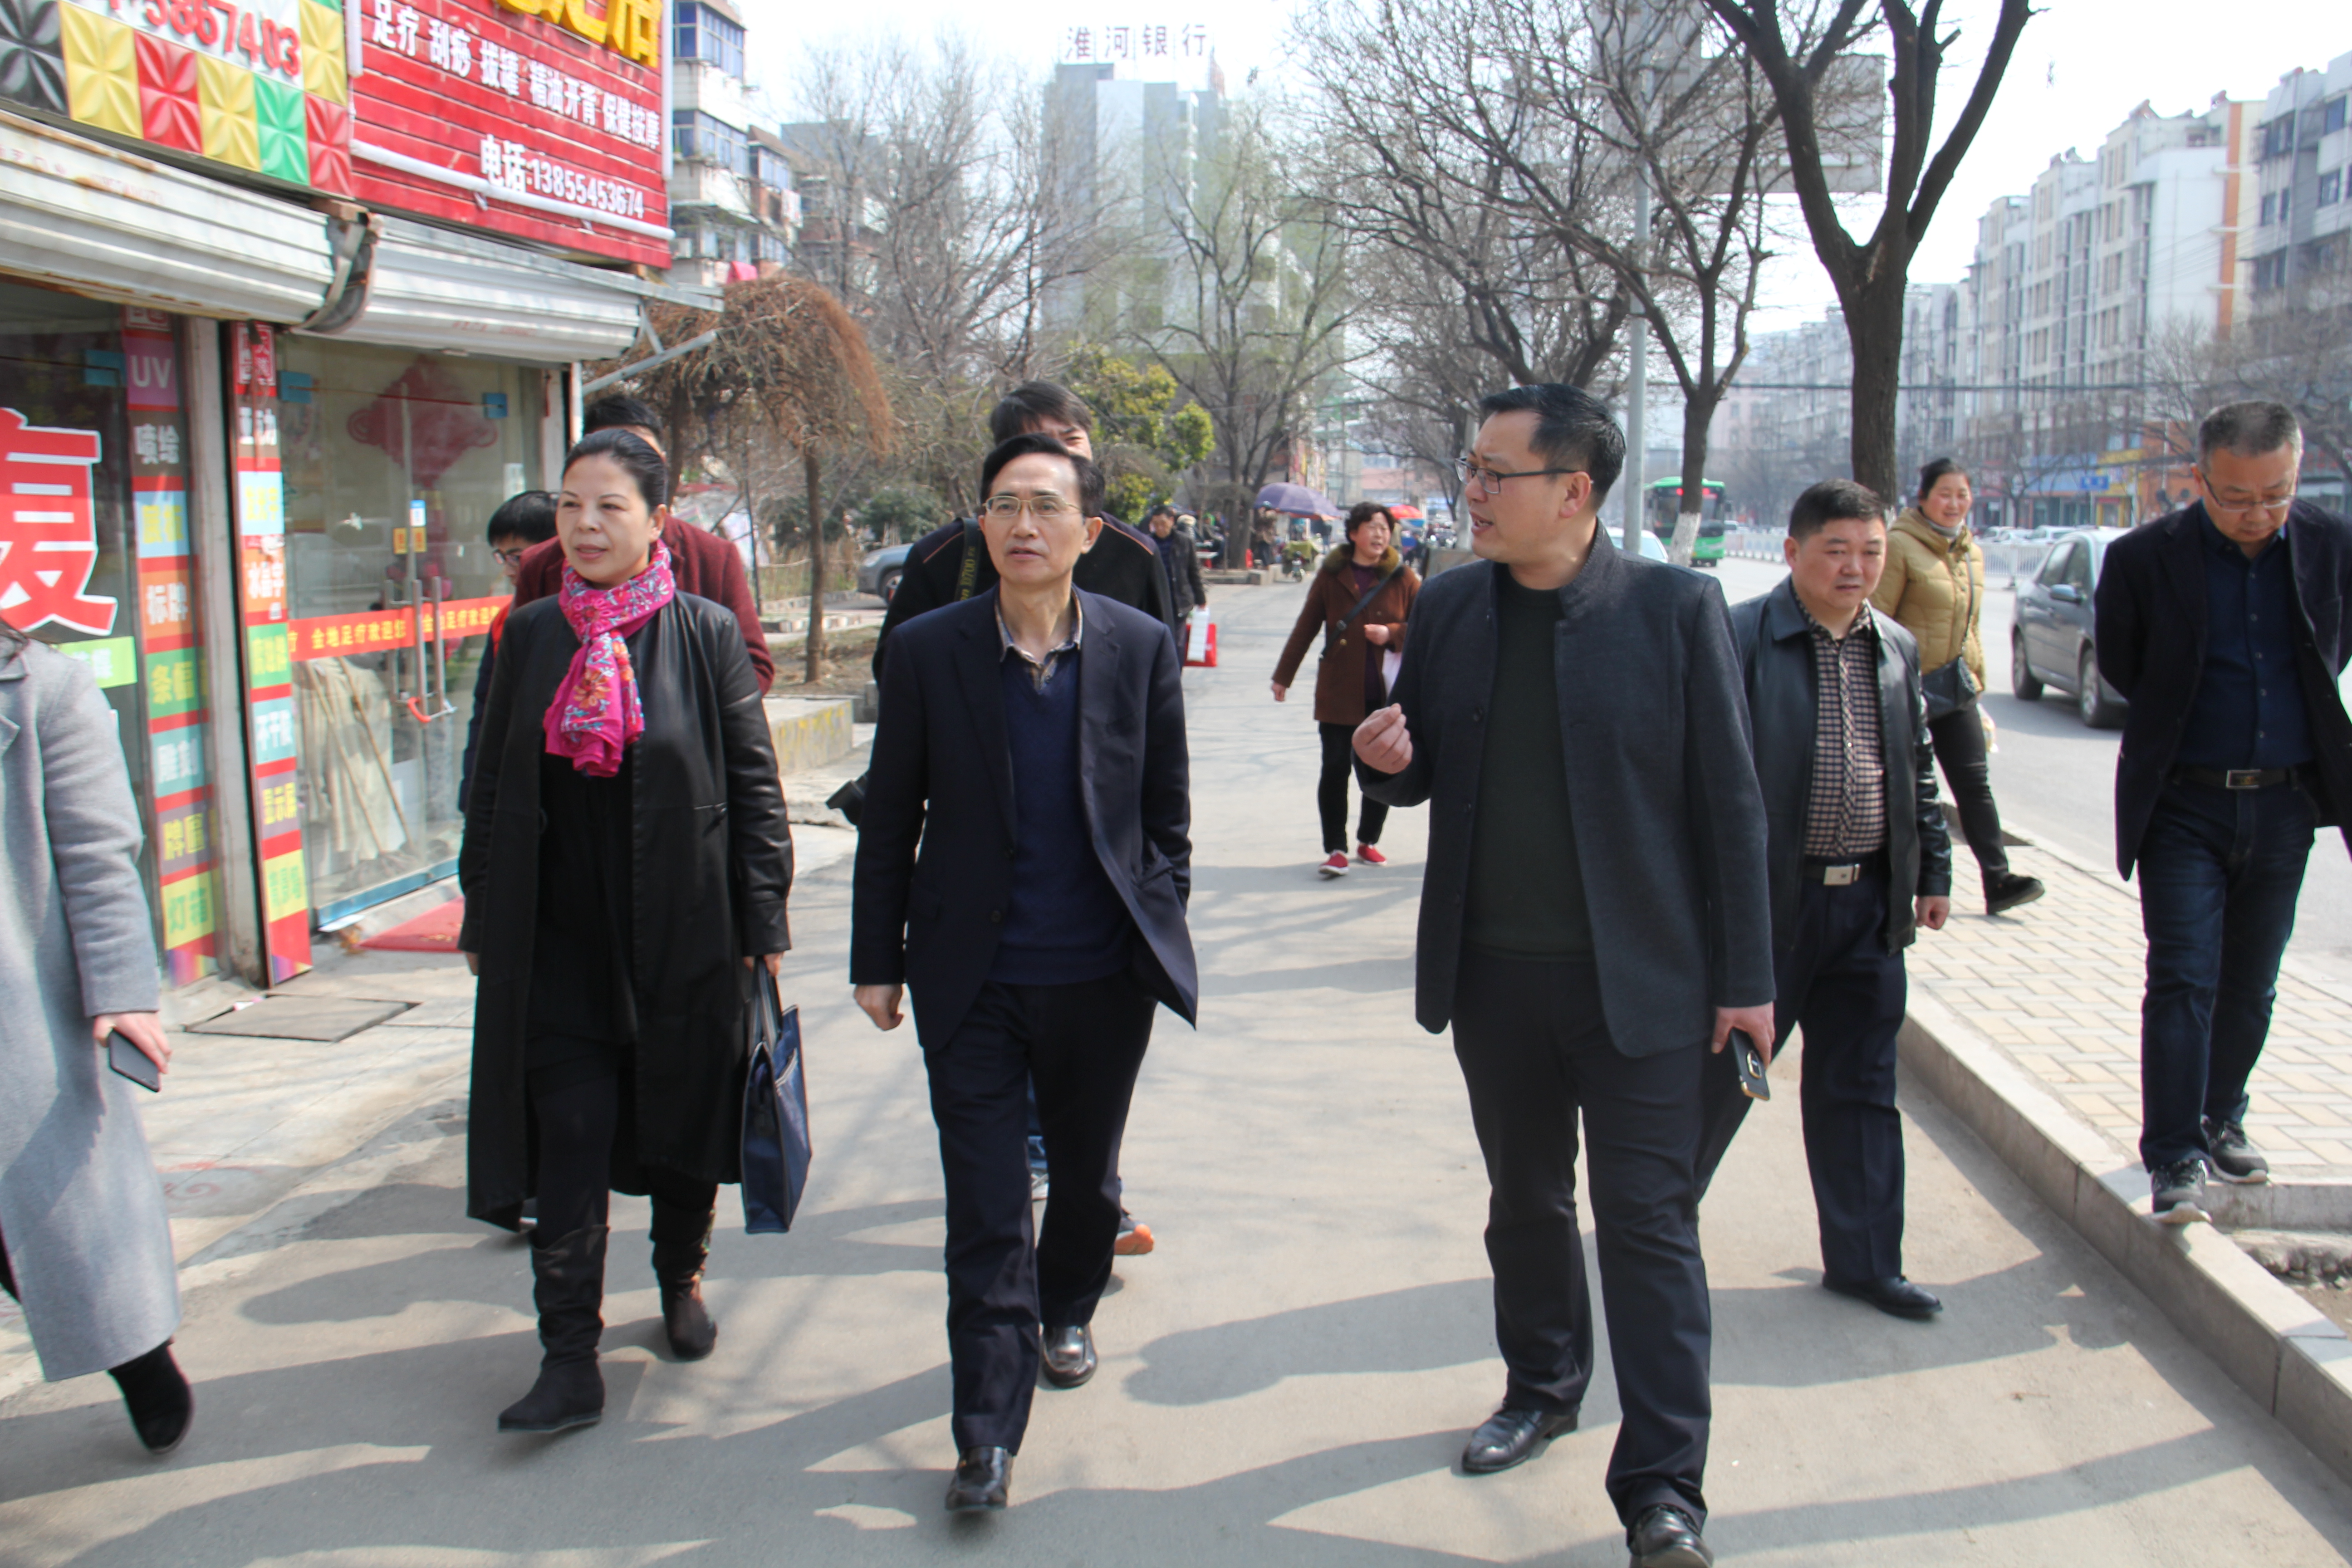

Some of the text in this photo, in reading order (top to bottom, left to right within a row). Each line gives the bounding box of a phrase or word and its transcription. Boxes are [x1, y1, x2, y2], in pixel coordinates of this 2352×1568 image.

[110, 0, 300, 76] 5867403
[1065, 24, 1206, 59] 淮河银行
[372, 0, 419, 56] 足疗
[428, 19, 472, 77] 刮痧
[603, 92, 660, 149] 保健按摩
[131, 355, 172, 389] UV
[132, 423, 180, 465] 喷绘
[146, 582, 188, 626] 标牌
[311, 619, 407, 650] 金地足疗欢迎您
[151, 661, 195, 705] 条幅
[263, 781, 298, 825] 显示屏
[168, 887, 208, 936] 灯箱
